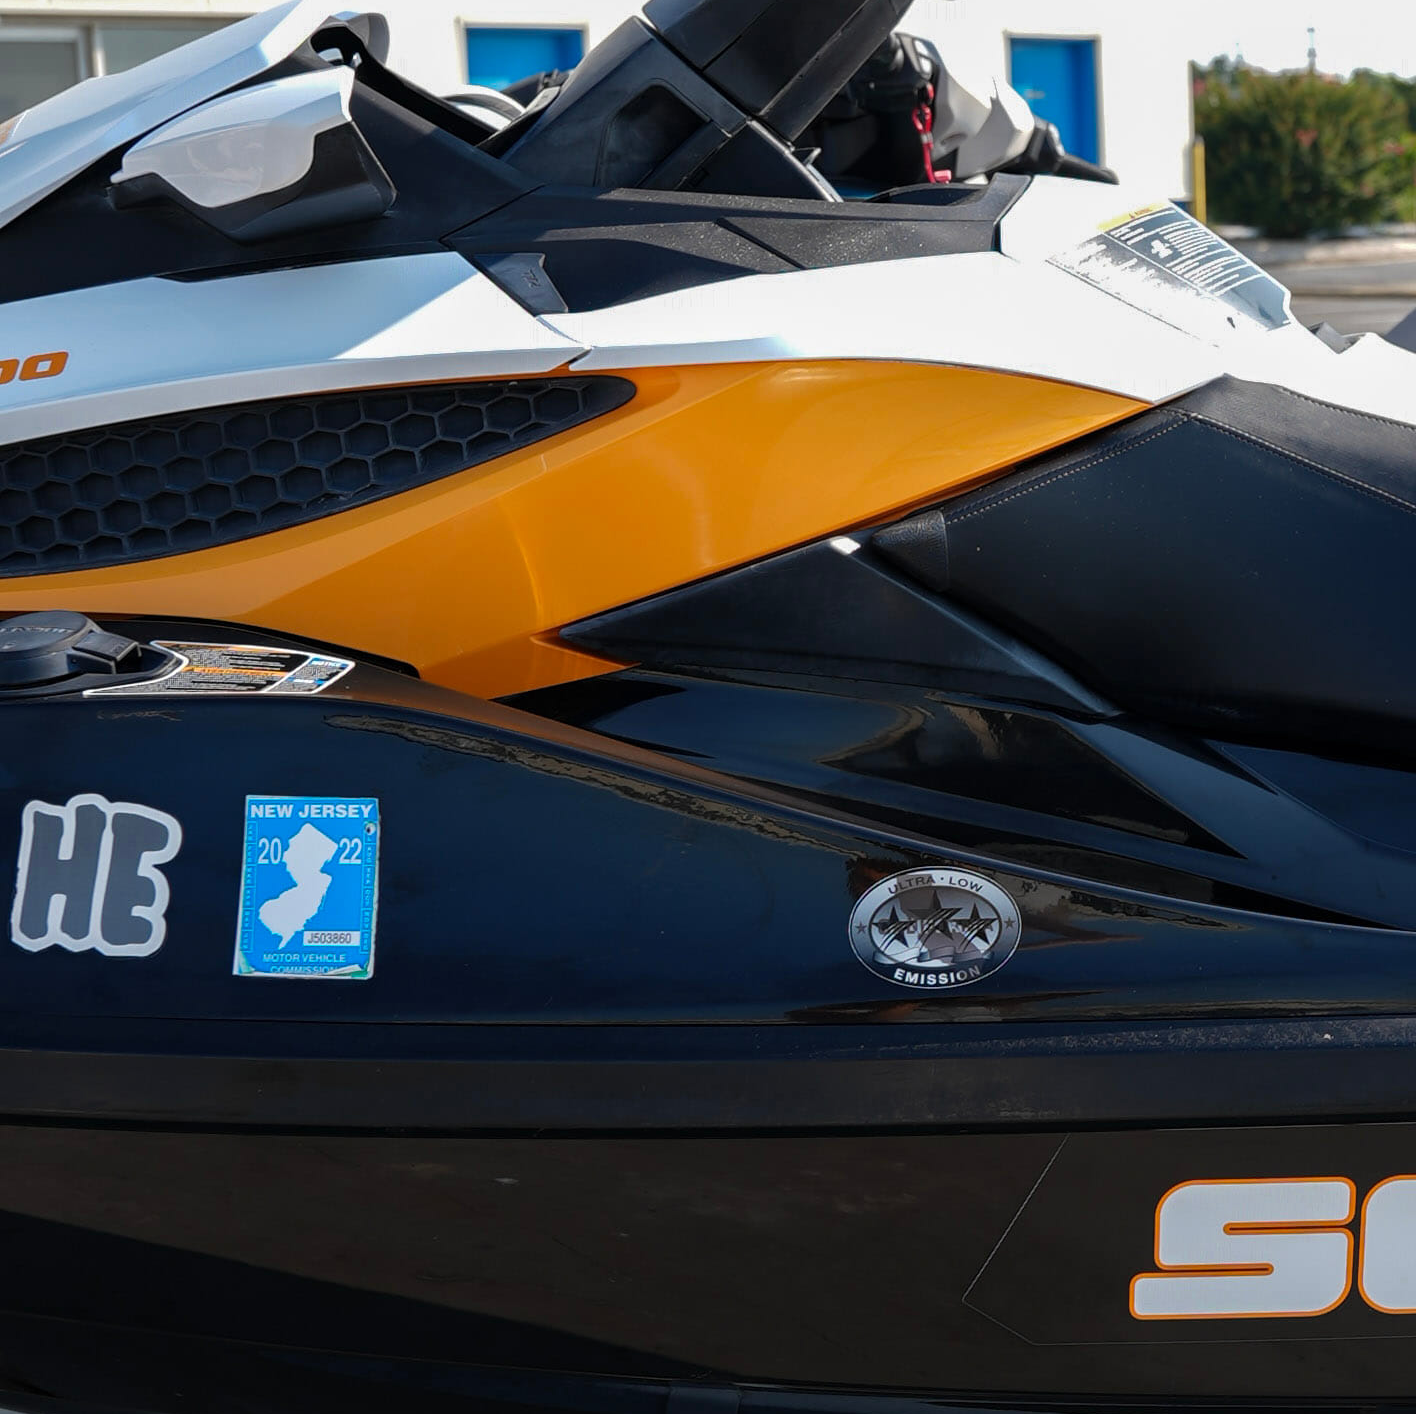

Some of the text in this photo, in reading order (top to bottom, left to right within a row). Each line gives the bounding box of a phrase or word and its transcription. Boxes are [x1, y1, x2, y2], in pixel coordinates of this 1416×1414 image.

[250, 803, 374, 819] NEW JERSEY
[257, 837, 362, 865] 20 22
[11, 793, 182, 957] HE
[887, 876, 983, 894] ULTRA LOW
[263, 953, 346, 963] MOTOR VEHICLE
[893, 965, 981, 986] EMISSION
